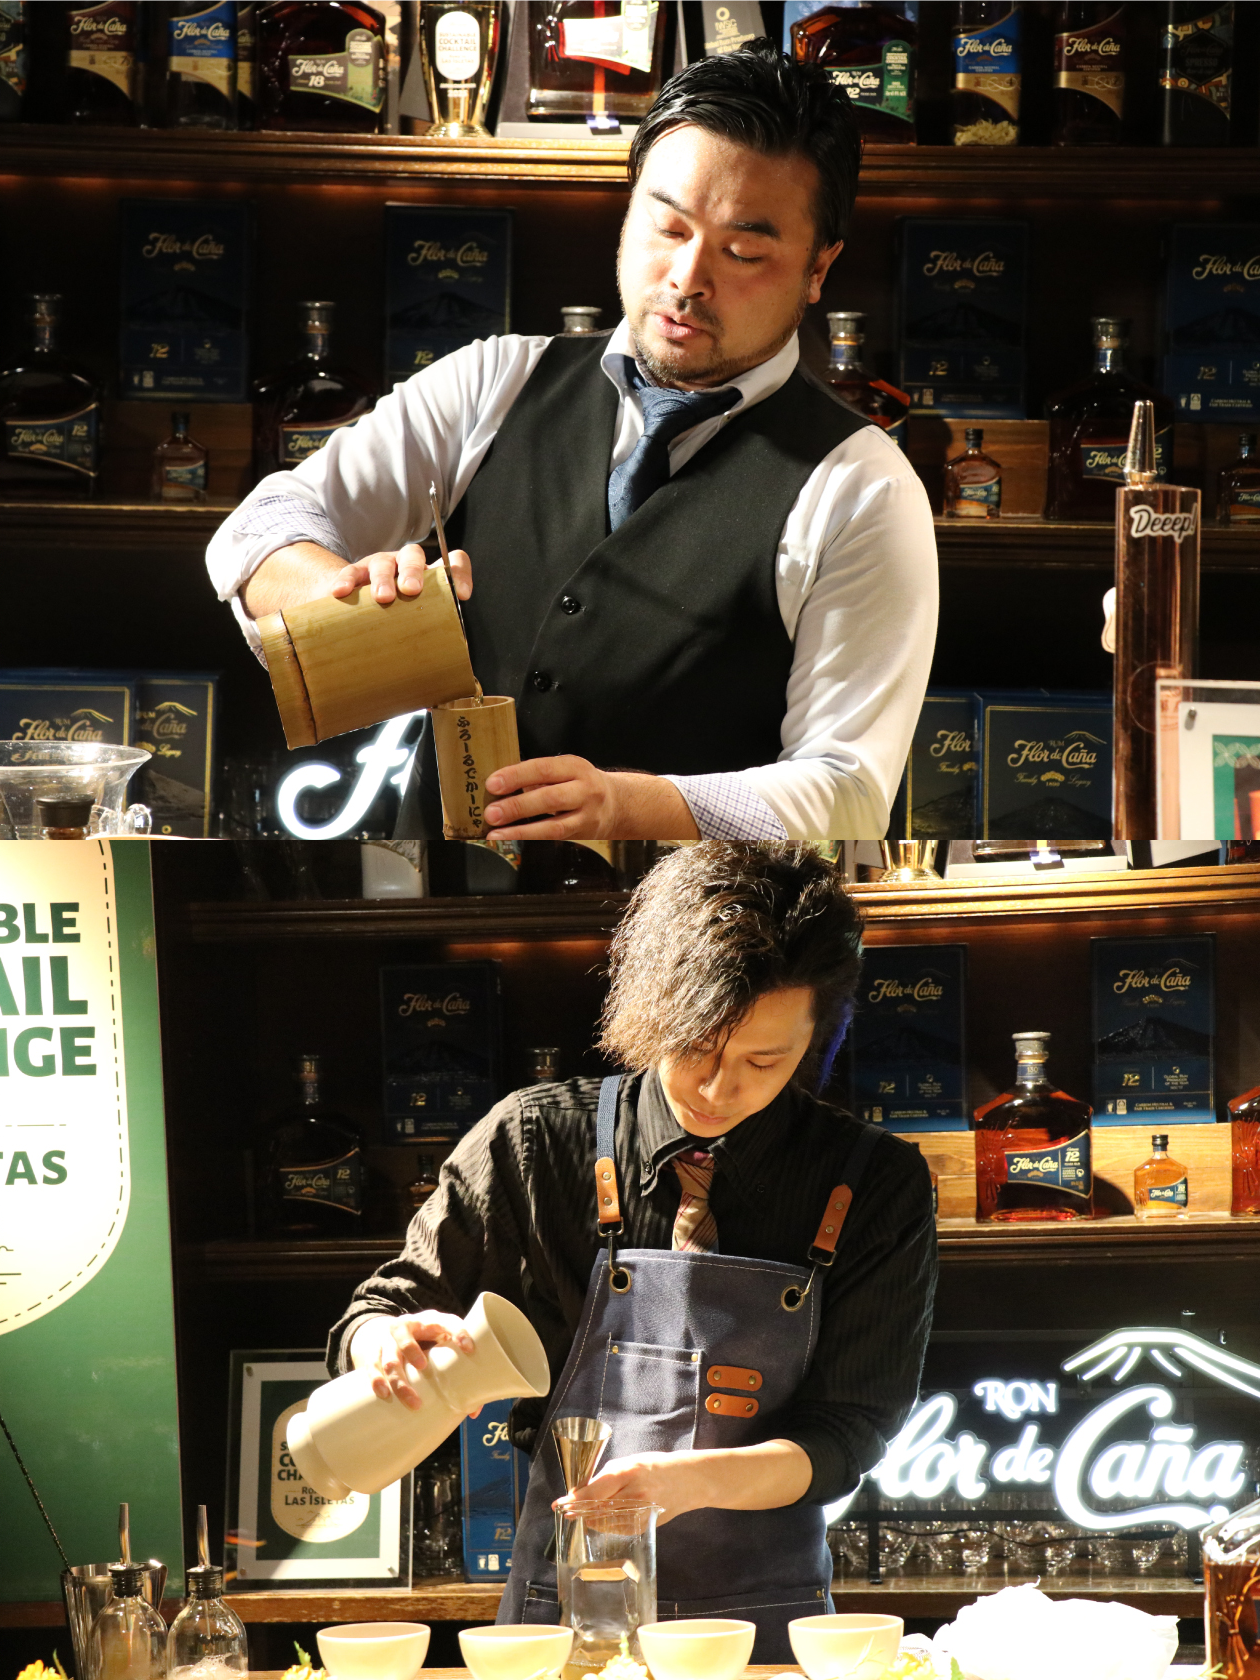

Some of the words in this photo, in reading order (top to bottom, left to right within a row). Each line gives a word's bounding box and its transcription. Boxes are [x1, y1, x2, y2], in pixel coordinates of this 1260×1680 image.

[70, 16, 97, 35] Flor
[104, 17, 127, 35] Caña
[174, 21, 201, 40] Flor
[207, 22, 230, 41] Caña
[957, 38, 983, 57] Flor
[990, 38, 1012, 56] Caña
[1064, 38, 1091, 56] Flor
[1098, 38, 1120, 56] Caña
[292, 59, 317, 76] Flor
[323, 60, 344, 77] Caña
[308, 75, 325, 87] 18
[143, 232, 181, 259] Flor
[192, 234, 224, 260] Caña
[407, 239, 445, 266] Flor
[456, 241, 488, 267] Caña
[924, 251, 960, 275] Flor
[972, 251, 1005, 276] Caña
[1193, 254, 1232, 280] Flor
[1232, 262, 1243, 272] de
[1243, 255, 1260, 280] Ca
[150, 343, 169, 358] 12
[930, 361, 948, 375] 12
[1197, 366, 1217, 380] 12
[72, 424, 87, 437] 12
[1086, 451, 1112, 468] Flor
[1134, 504, 1197, 539] Deeep!
[12, 719, 55, 741] Flor
[67, 720, 102, 741] Caña
[153, 713, 187, 739] Caña
[930, 730, 971, 756] Flor
[1007, 739, 1050, 767] Flor
[1050, 751, 1062, 761] de
[1061, 742, 1097, 768] Caña
[457, 715, 482, 828] ふろーるでかーにゃ
[0, 957, 88, 1016] IL
[868, 979, 903, 1003] Flor
[904, 985, 914, 994] de
[913, 977, 943, 1001] Caña
[1113, 970, 1149, 993] Flor
[1151, 975, 1161, 984] de
[1160, 968, 1191, 992] Caña
[399, 993, 433, 1016] Flor
[443, 992, 471, 1015] Caña
[0, 1026, 97, 1077] GE
[878, 1081, 896, 1094] 12
[1122, 1074, 1140, 1087] 12
[409, 1092, 427, 1107] 12
[1010, 1157, 1033, 1173] Flor
[1040, 1157, 1058, 1172] Caña
[1065, 1150, 1080, 1162] 12
[2, 1150, 68, 1186] AS
[336, 1168, 351, 1180] 12
[974, 1379, 1058, 1419] RON
[877, 1393, 989, 1499] lor
[991, 1422, 1054, 1483] de
[1055, 1384, 1247, 1530] Caña
[285, 1495, 306, 1505] LAS
[494, 1528, 512, 1540] 12
